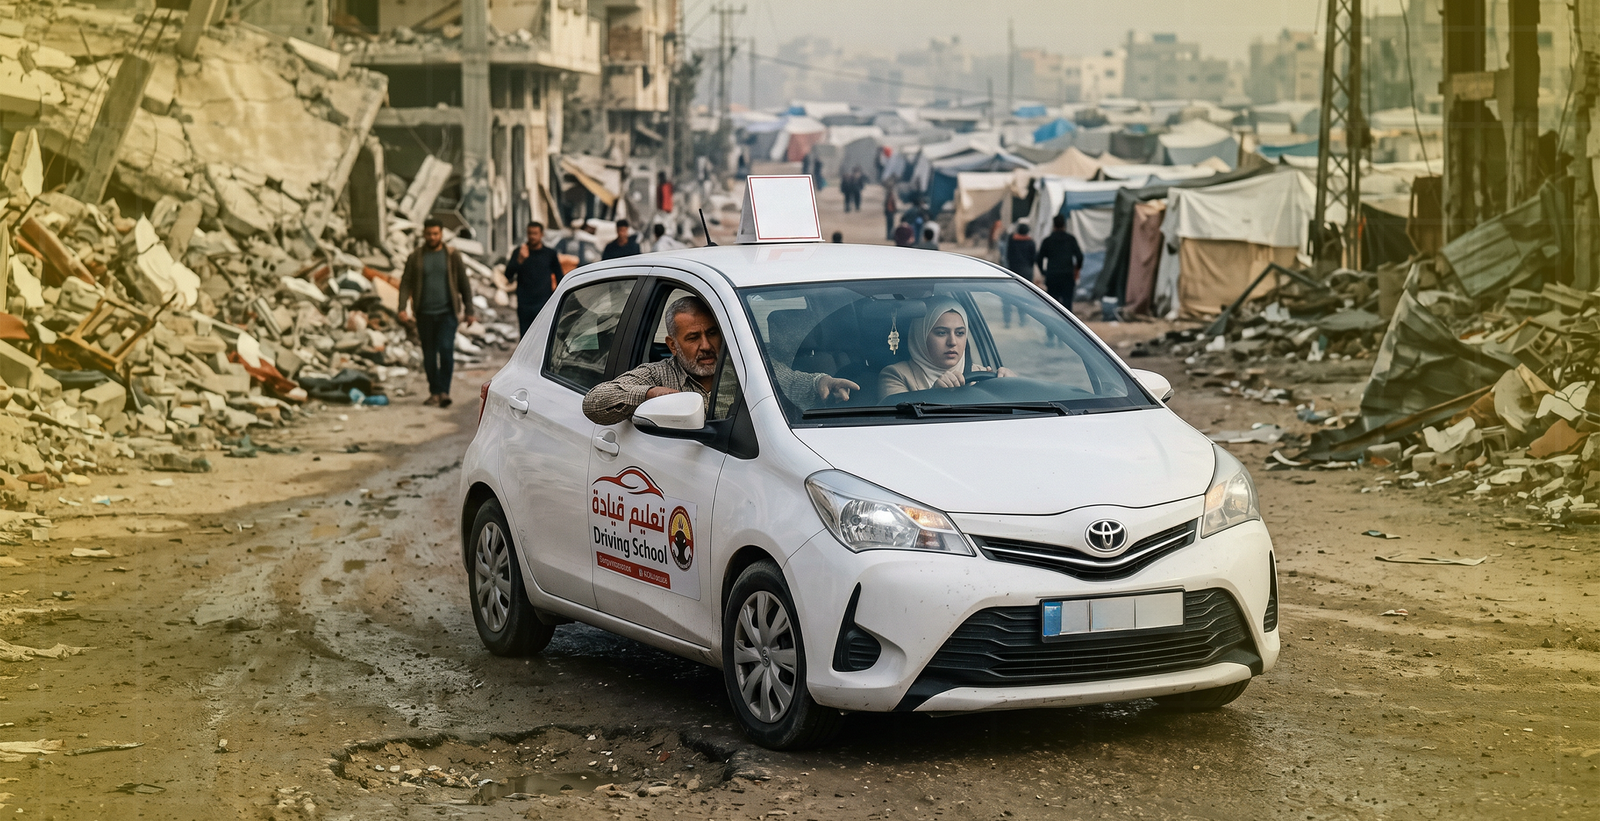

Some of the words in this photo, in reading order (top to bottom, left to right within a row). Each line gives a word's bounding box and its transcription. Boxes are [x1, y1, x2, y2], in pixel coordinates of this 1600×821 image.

[592, 489, 625, 527] قيادة
[628, 503, 665, 535] تعليم
[593, 526, 630, 558] Driving
[632, 537, 668, 564] School
